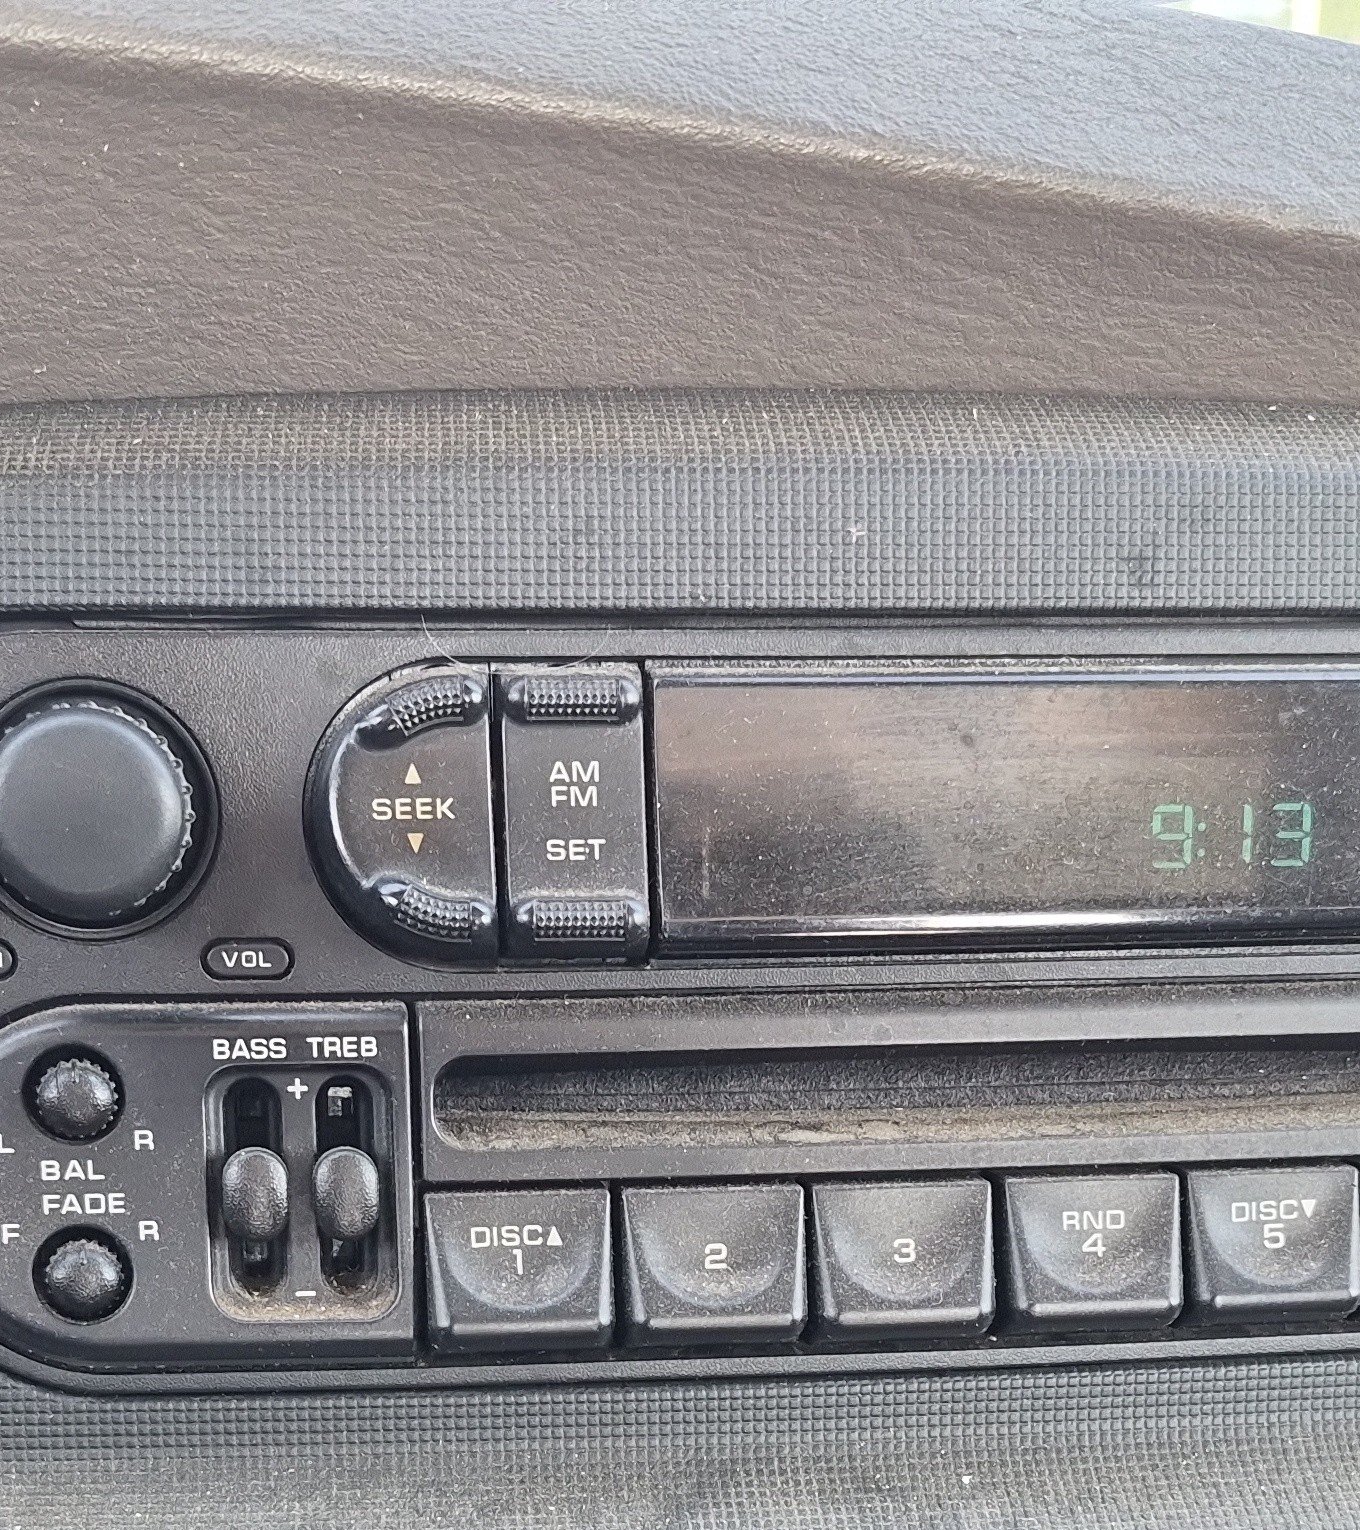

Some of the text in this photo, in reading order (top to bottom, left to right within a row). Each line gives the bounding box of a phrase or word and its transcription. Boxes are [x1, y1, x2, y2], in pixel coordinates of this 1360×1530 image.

[549, 760, 600, 783] AM
[550, 785, 598, 808] FM
[371, 797, 456, 821] SEEK
[1150, 802, 1314, 869] 9:13
[546, 838, 607, 861] SET
[221, 950, 272, 968] VOL
[212, 1037, 287, 1060] BASS
[305, 1036, 378, 1058] TREB
[133, 1129, 155, 1151] R
[39, 1159, 106, 1181] BAL
[42, 1192, 126, 1216] FADE
[1231, 1199, 1299, 1223] DISC
[138, 1220, 160, 1241] R
[1062, 1209, 1126, 1230] RND
[0, 1223, 21, 1245] F
[470, 1224, 544, 1249] DISC
[1081, 1232, 1107, 1258] 4
[1263, 1222, 1286, 1249] 5
[512, 1248, 524, 1276] 1
[704, 1242, 728, 1270] 2
[892, 1237, 916, 1264] 3
